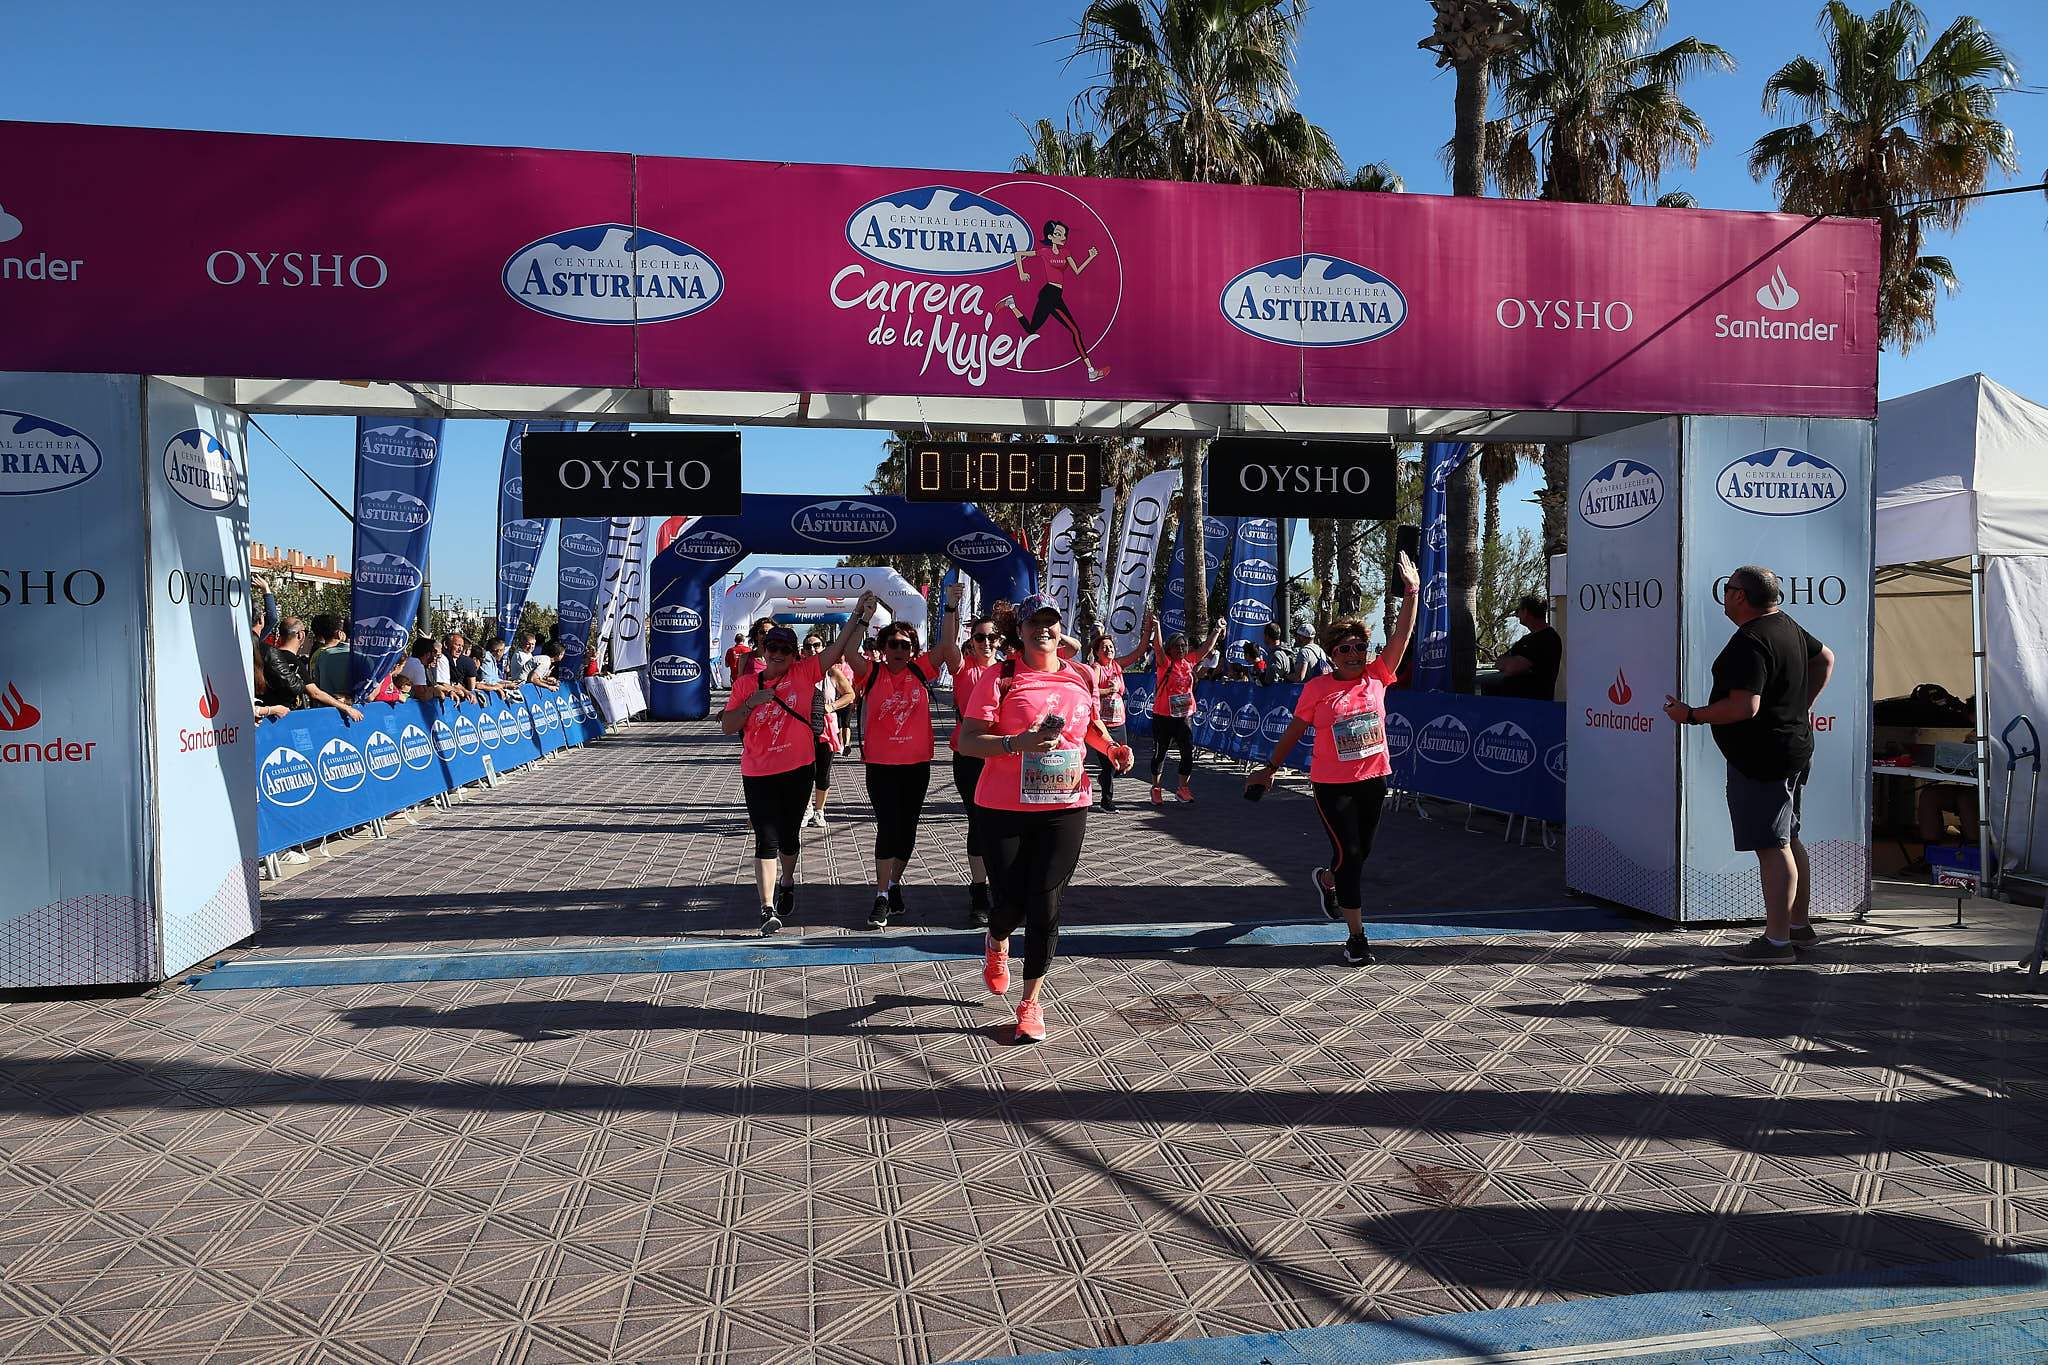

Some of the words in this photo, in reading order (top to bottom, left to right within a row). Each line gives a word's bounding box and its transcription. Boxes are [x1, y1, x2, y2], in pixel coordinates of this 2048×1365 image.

[861, 215, 1018, 255] ASTURIANA
[890, 214, 948, 225] CENTRAL
[955, 219, 1014, 228] LECHERA
[206, 251, 388, 288] OYSHO
[554, 258, 622, 268] CENTRAL
[520, 258, 708, 300] ASTURIANA
[830, 264, 984, 315] Carrera
[1264, 285, 1322, 295] CENTRAL
[1328, 287, 1387, 297] LECHERA
[1235, 285, 1393, 324] ASTURIANA
[1496, 298, 1632, 332] OYSHO
[1714, 313, 1840, 342] Santander
[868, 314, 897, 346] de
[903, 314, 924, 347] la
[919, 312, 1041, 387] Mujer
[170, 450, 234, 496] ASTURIANA
[558, 459, 711, 490] OYSHO
[921, 452, 1086, 492] 01:08:18
[1240, 464, 1370, 494] OYSHO
[1725, 472, 1836, 499] ASTURIANA
[1584, 488, 1657, 516] ASTURIANA
[800, 513, 889, 533] ASTURIANA
[679, 541, 736, 554] ASTURIANA
[953, 544, 1008, 554] ASTURIANA
[1110, 496, 1160, 634] OYSHO
[168, 569, 242, 608] OYSHO
[784, 574, 866, 590] OYSHO
[1579, 578, 1663, 612] OYSHO
[654, 614, 698, 626] ASTURIANA
[652, 664, 698, 676] ASTURIANA
[1585, 708, 1654, 732] Santander
[180, 723, 240, 754] Santander
[1477, 736, 1528, 764] ASTURIANA
[323, 760, 364, 782] ASTURIANA
[369, 750, 400, 772] ASTURIANA
[266, 771, 314, 796] ASTURIANA
